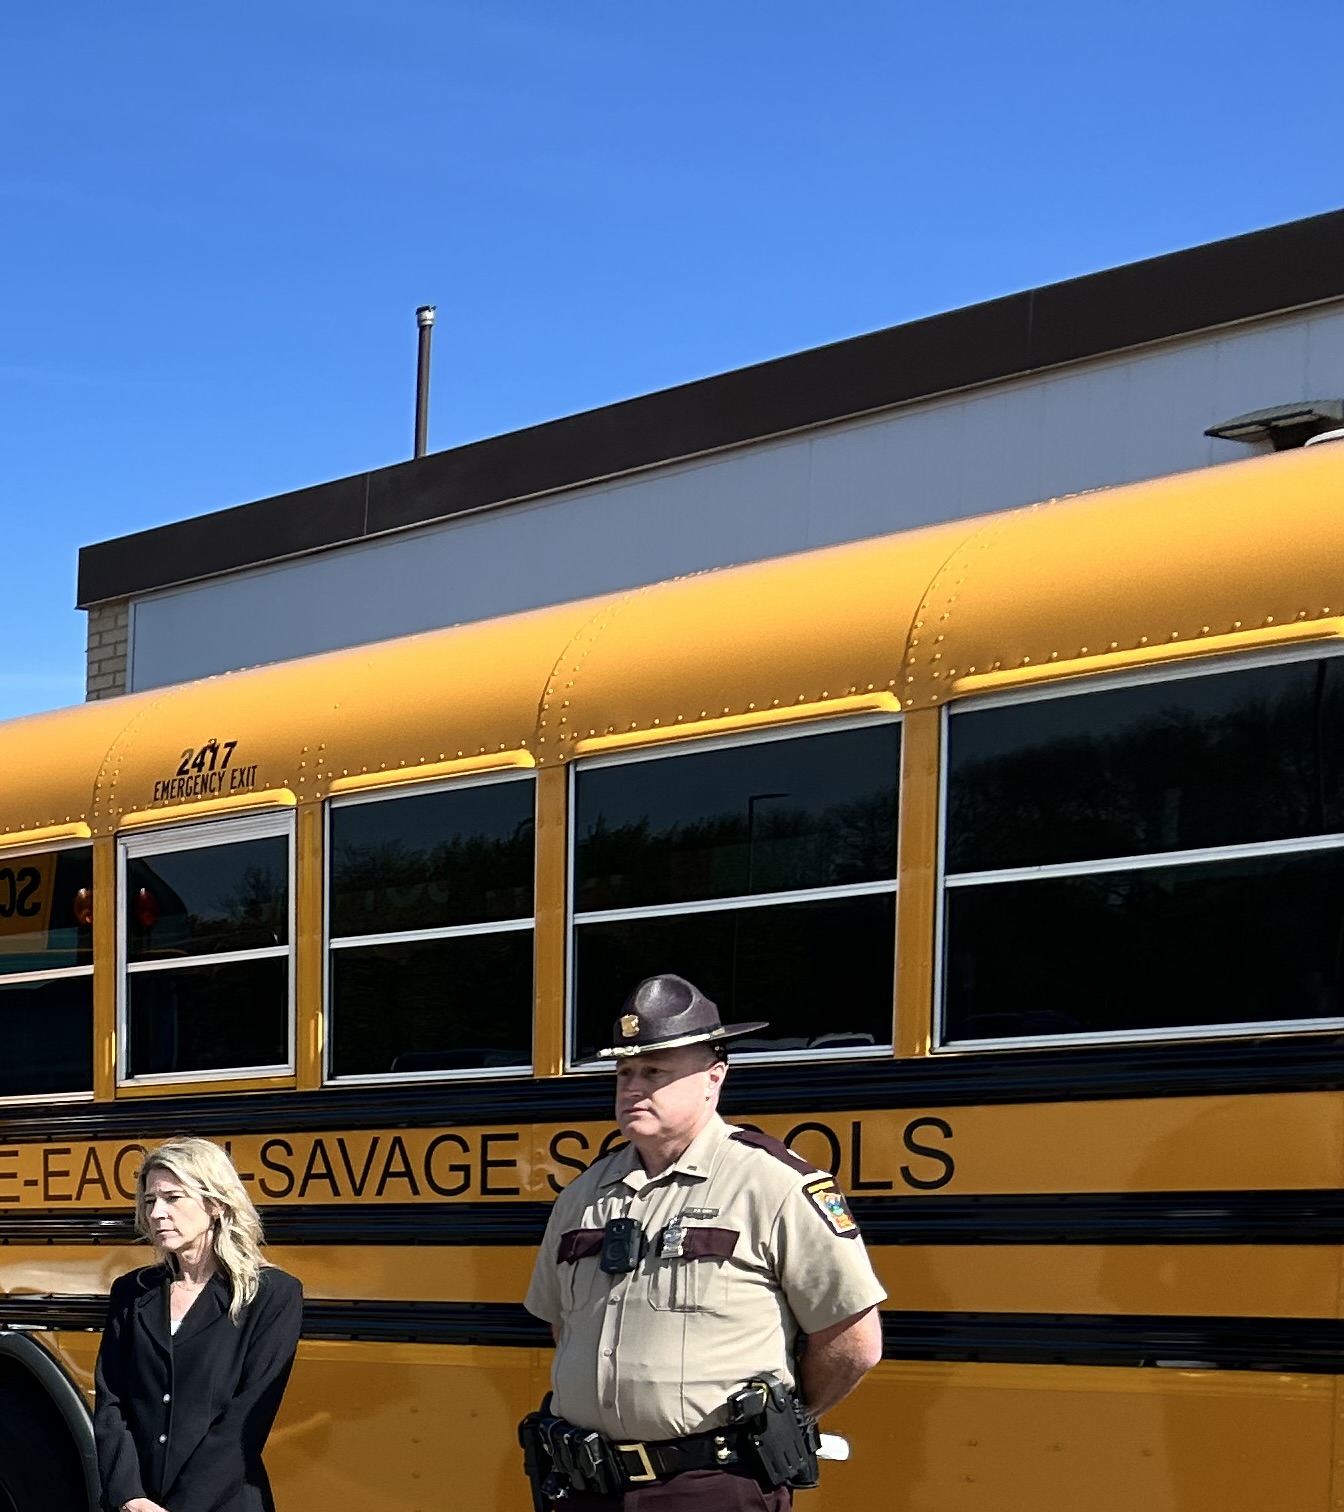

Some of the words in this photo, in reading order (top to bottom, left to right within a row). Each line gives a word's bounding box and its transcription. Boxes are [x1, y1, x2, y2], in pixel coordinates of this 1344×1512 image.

[176, 740, 238, 776] 2417
[153, 770, 226, 801] EMERGENCY
[230, 765, 258, 789] EXIT
[547, 1116, 955, 1197] SOLS
